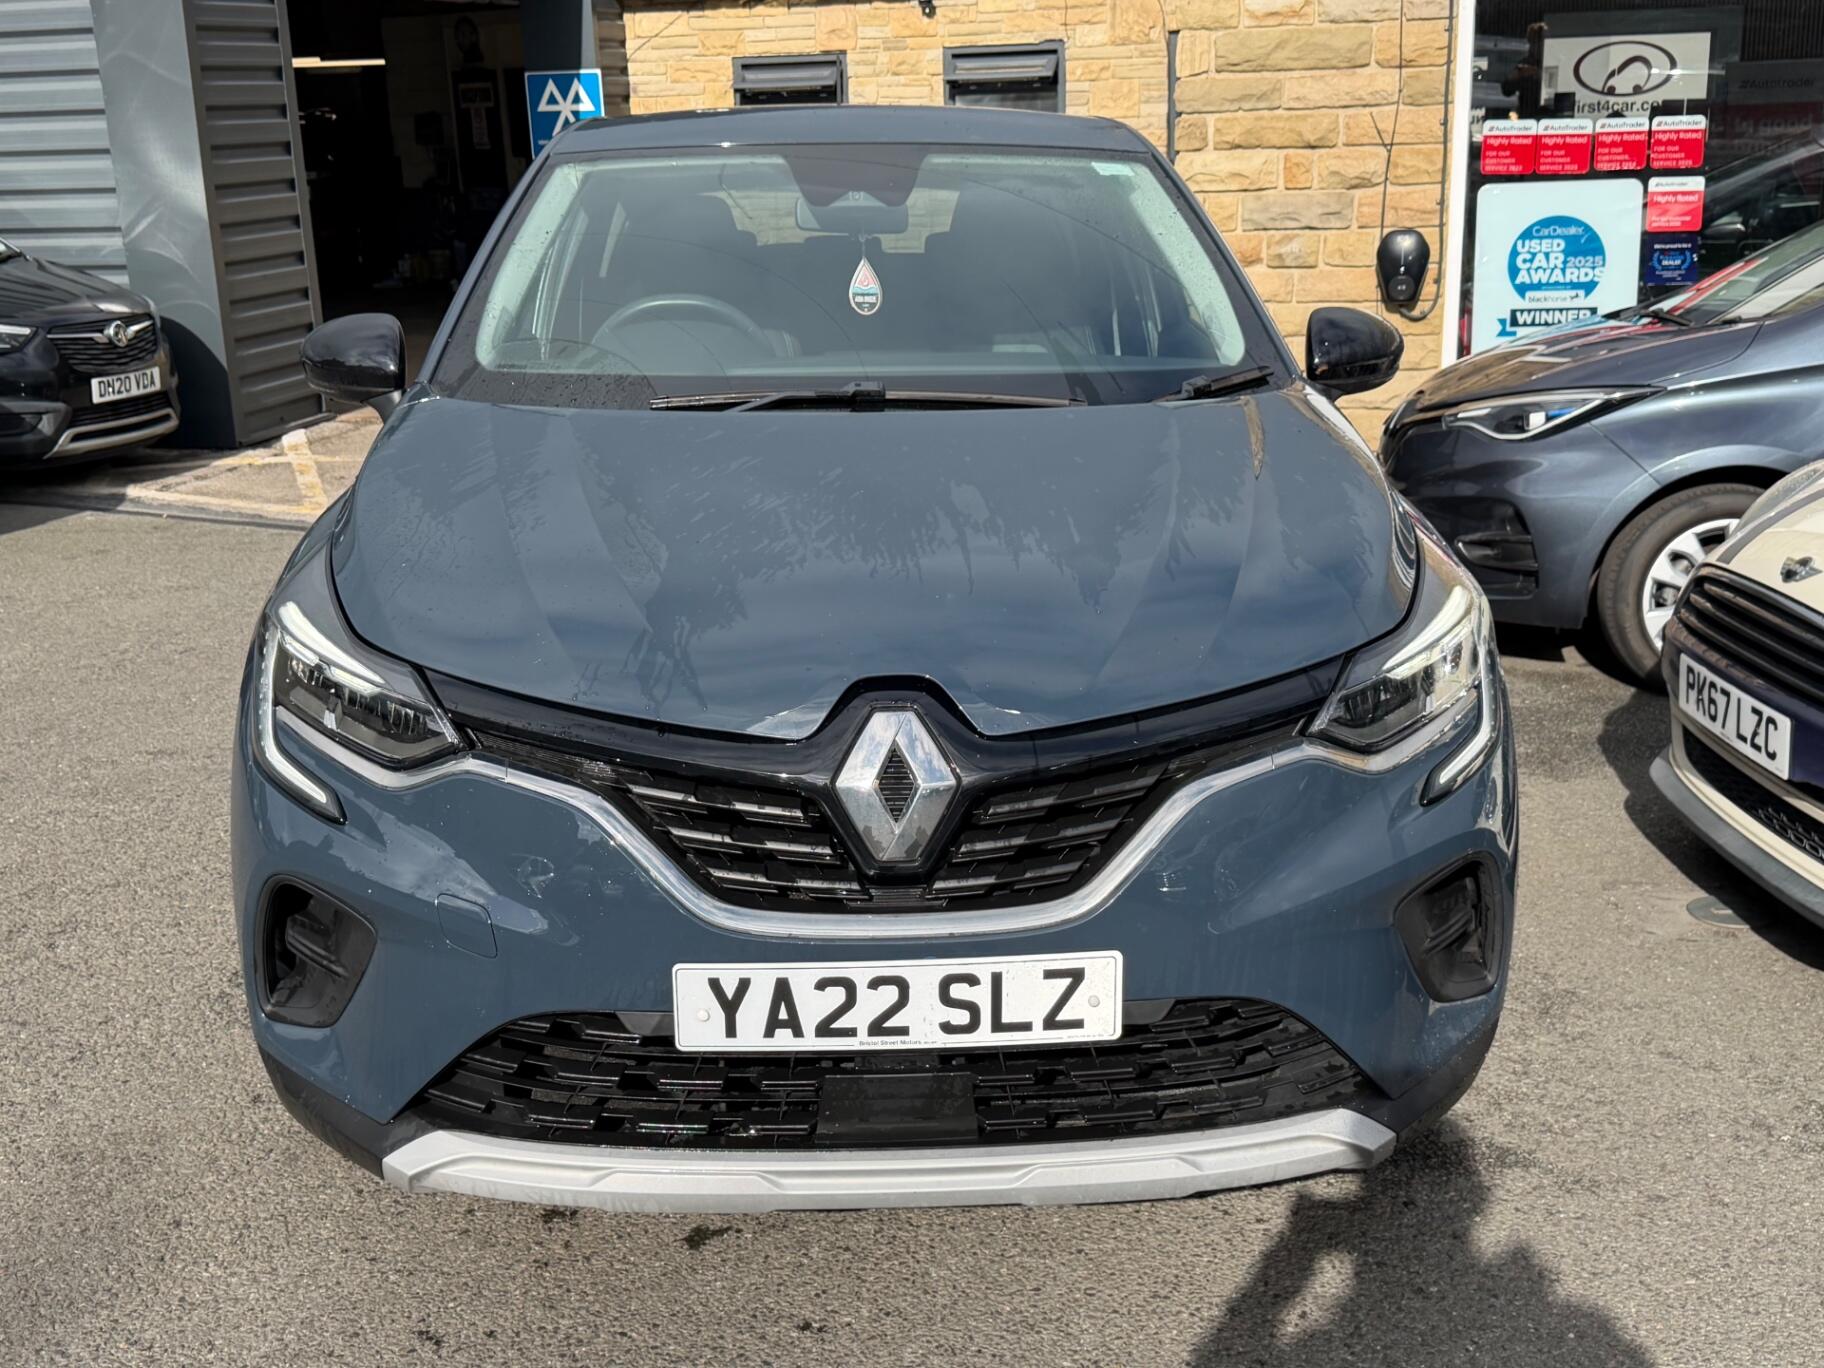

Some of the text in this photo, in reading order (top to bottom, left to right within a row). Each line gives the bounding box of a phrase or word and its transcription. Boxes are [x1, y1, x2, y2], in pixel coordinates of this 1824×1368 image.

[1486, 137, 1533, 147] Highly Rated
[1541, 136, 1588, 146] Highly Rated
[1598, 133, 1645, 144] Highly Rated
[1654, 131, 1702, 142] Highly Rated
[1653, 193, 1699, 204] Highly Rated
[1532, 226, 1583, 236] CarDealer
[1516, 238, 1566, 253] USED
[1515, 253, 1604, 269] CAR 2025
[1514, 267, 1606, 284] AWARDS
[98, 370, 156, 398] DN20 VDA
[1686, 665, 1778, 761] PK67 LZC
[707, 967, 1085, 1039] YA22 SLZ
